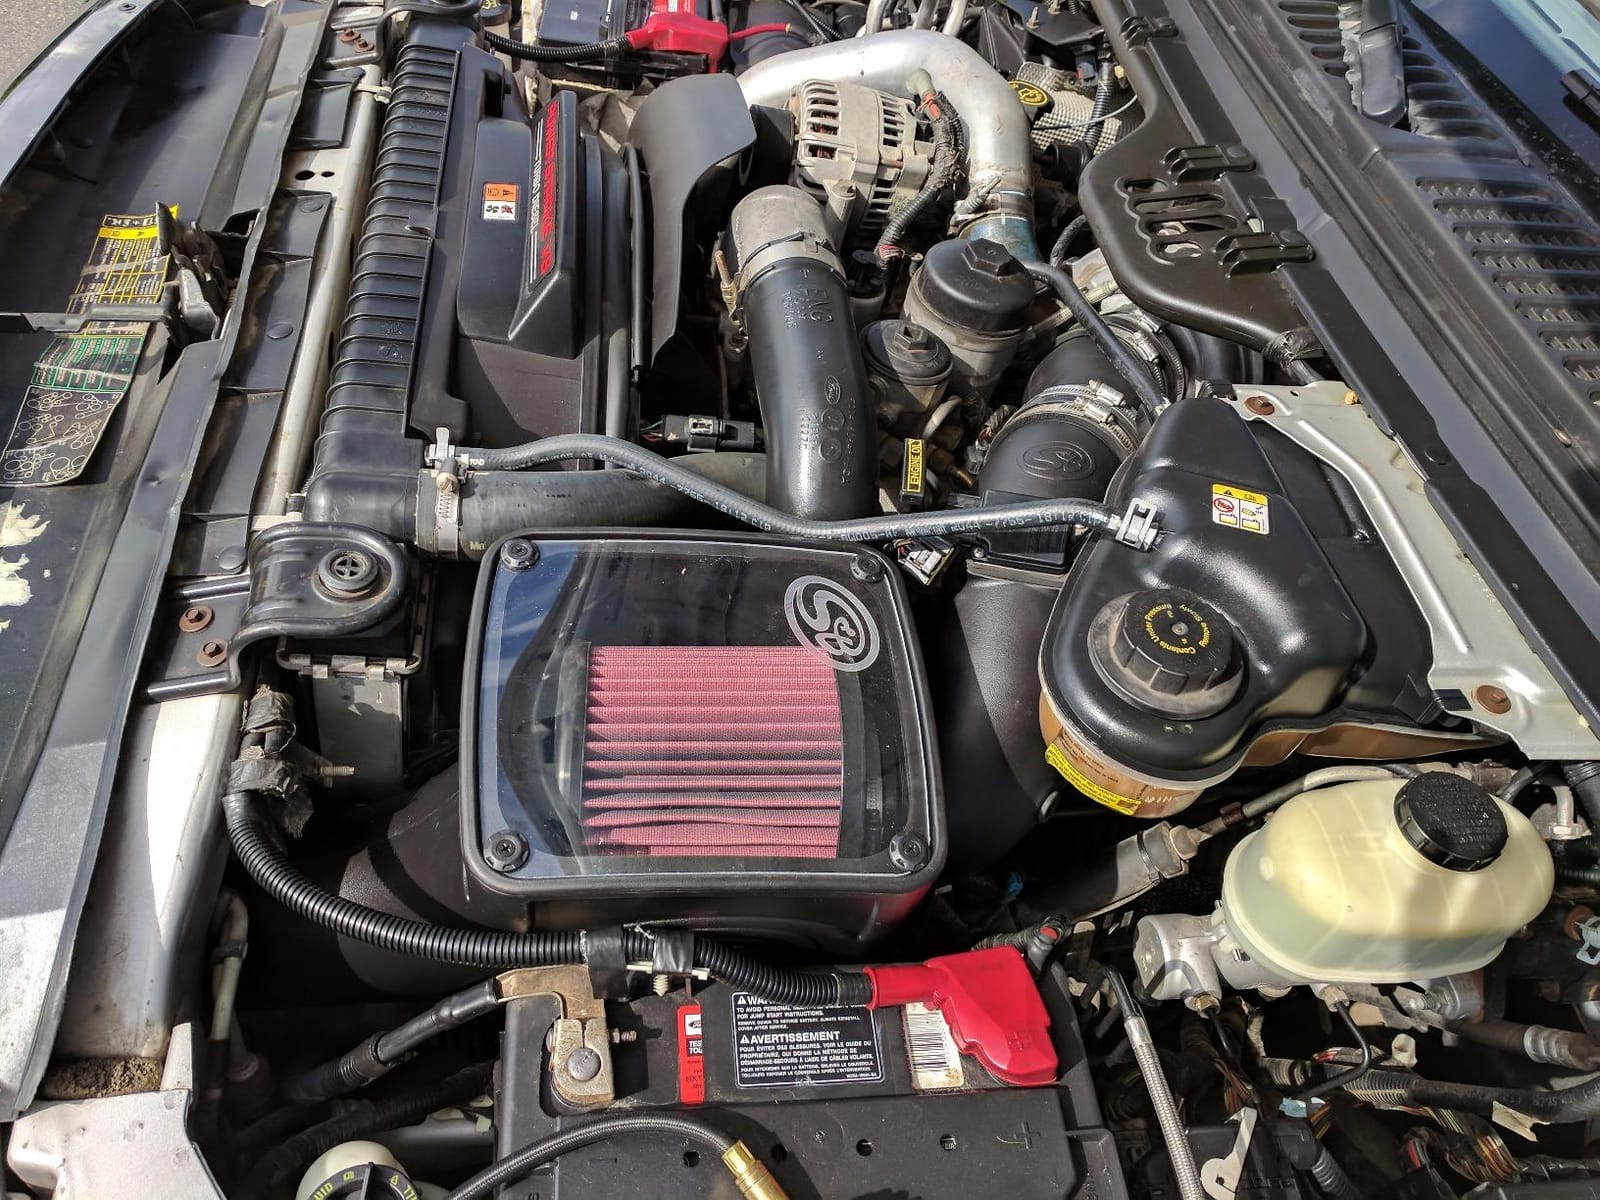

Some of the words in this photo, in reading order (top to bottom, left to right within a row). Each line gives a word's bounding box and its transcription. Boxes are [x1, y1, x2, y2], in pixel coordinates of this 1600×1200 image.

[910, 455, 921, 484] ENGINE
[1144, 603, 1172, 622] Pressure
[1179, 604, 1203, 622] Slowly
[1145, 621, 1160, 643] Under
[1198, 622, 1211, 648] Remove
[1159, 640, 1197, 655] Contents
[750, 1031, 840, 1044] AVERTISSEMENT
